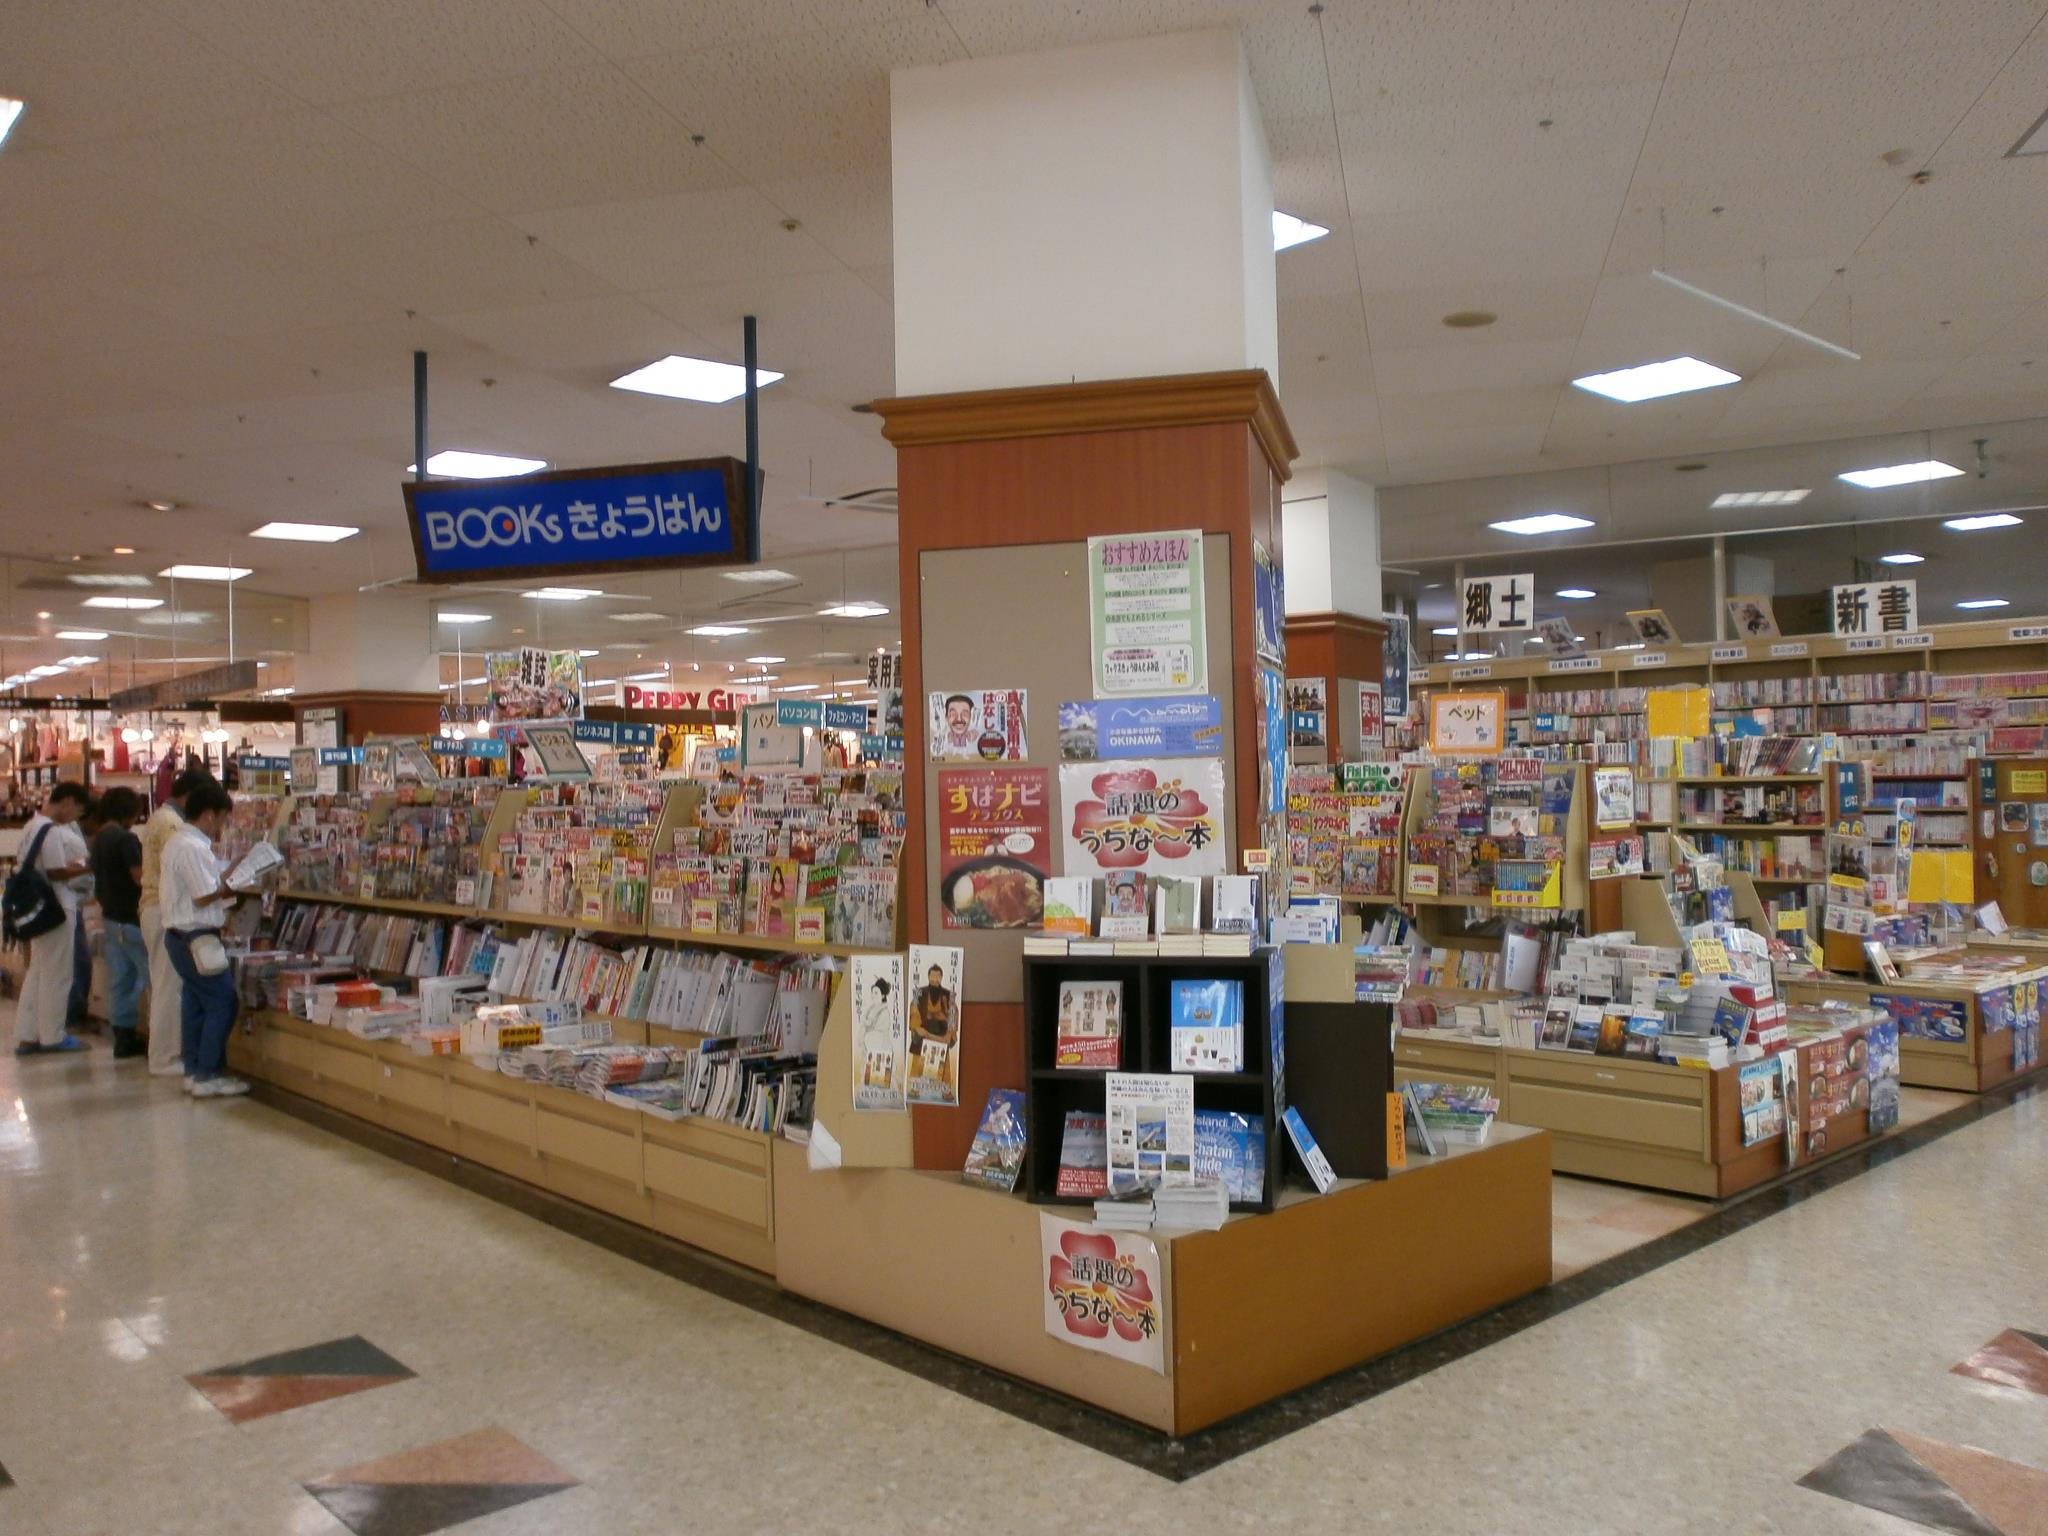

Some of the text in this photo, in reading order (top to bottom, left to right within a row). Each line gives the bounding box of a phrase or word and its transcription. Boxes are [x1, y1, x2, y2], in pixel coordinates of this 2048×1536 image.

[567, 492, 721, 541] きょうはん
[1102, 538, 1189, 566] おすすめえほん
[1466, 579, 1527, 629] 郷土
[1837, 585, 1911, 634] 新書
[522, 648, 547, 687] 雑誌
[624, 686, 701, 711] PEPPY
[781, 706, 817, 722] パソコン誌
[667, 724, 713, 735] SALE
[1110, 736, 1162, 746] OKINAWA
[1498, 759, 1541, 774] MILITARY
[948, 783, 1042, 813] すばナビ
[1105, 791, 1179, 817] 話題の
[1071, 1254, 1135, 1287] 話題の
